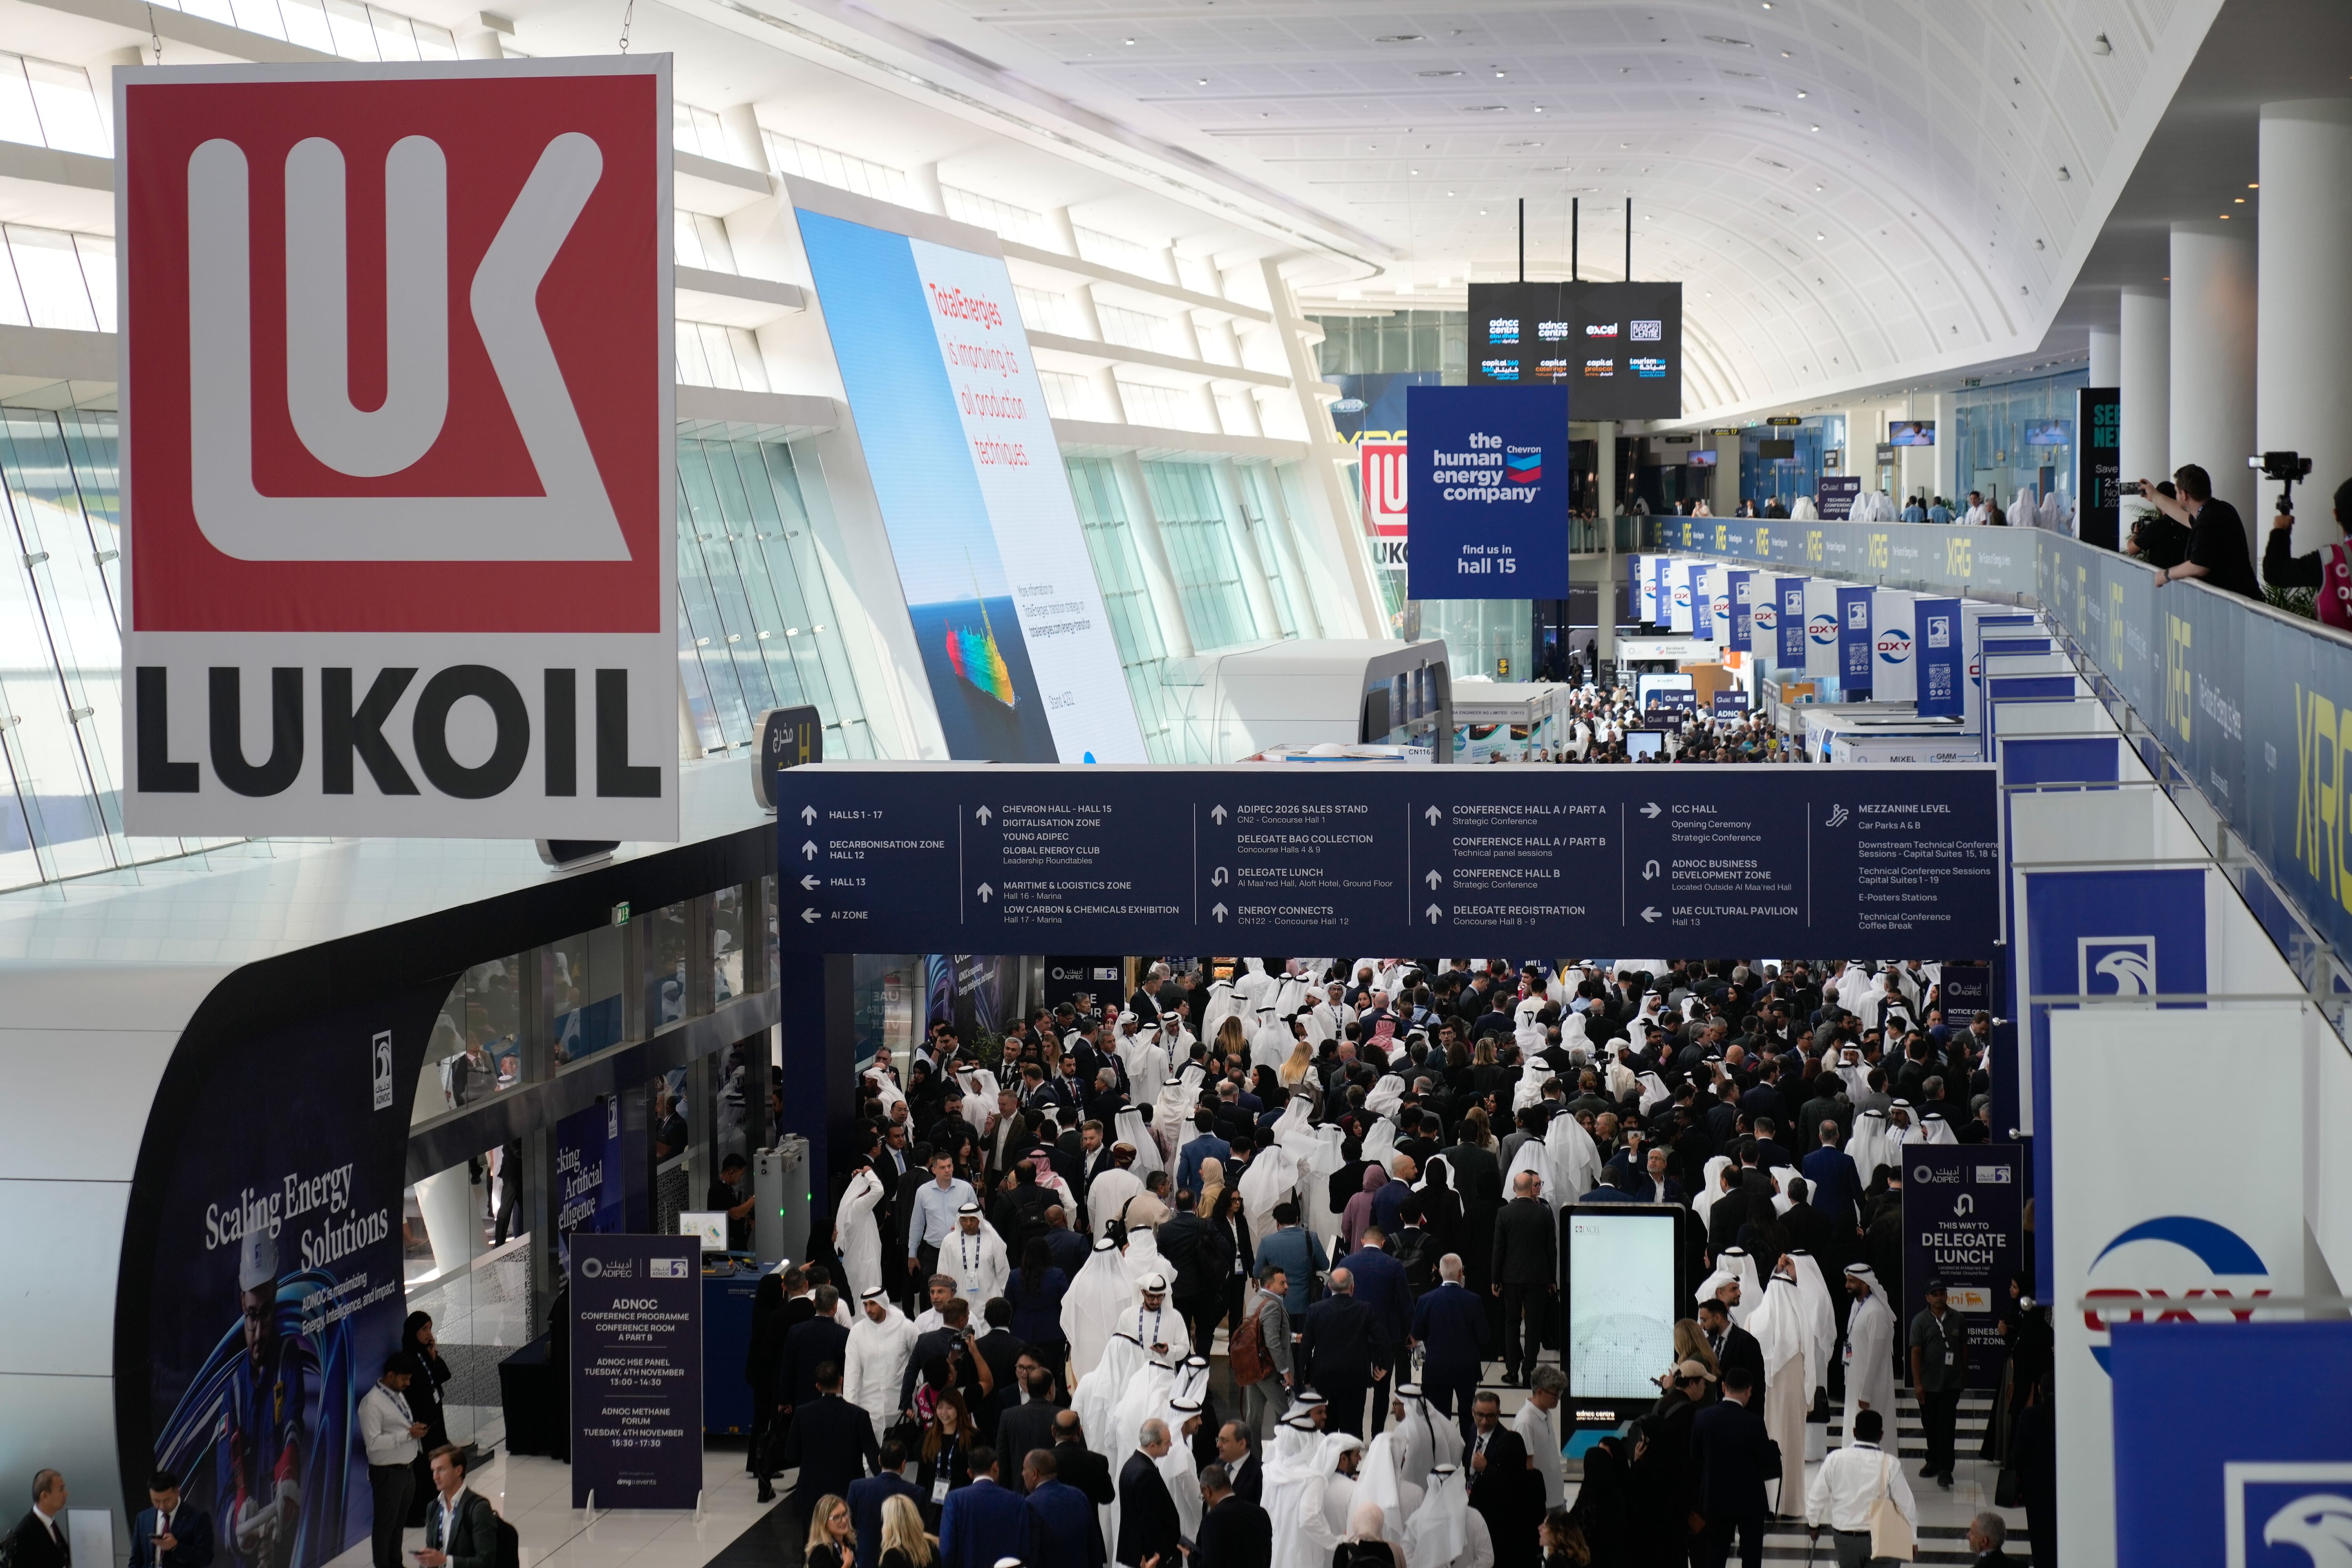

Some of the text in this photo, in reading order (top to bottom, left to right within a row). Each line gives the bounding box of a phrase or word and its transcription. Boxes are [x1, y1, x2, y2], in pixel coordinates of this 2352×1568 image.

[930, 283, 1002, 330] TotalEnergies
[1586, 323, 1618, 334] excel
[944, 333, 1018, 378] is improving its
[1541, 359, 1567, 367] capital
[1587, 359, 1613, 367] capital
[962, 384, 1027, 421] oil production
[1469, 432, 1502, 448] the
[1434, 450, 1502, 466] human
[2096, 464, 2118, 473] Save
[1433, 470, 1503, 486] energy
[1462, 545, 1484, 554] find
[1502, 545, 1511, 554] in
[1806, 531, 1822, 562] XRG
[1868, 534, 1887, 568] XRG
[1947, 537, 1971, 577] XRG
[1458, 558, 1516, 573] hall 15
[1878, 641, 1911, 651] OXY
[2166, 611, 2191, 743] XRG
[135, 664, 661, 800] LUKOIL
[773, 722, 793, 753] مخرج
[1275, 805, 1300, 814] 2026
[1335, 805, 1368, 813] STAND
[1672, 805, 1717, 813] ICC HALL
[1859, 804, 1951, 813] MEZZANINE LEVEL
[1453, 817, 1489, 826] Strategic
[1671, 820, 1751, 830] Opening Ceremony
[1238, 868, 1323, 877] DELEGATE LUNCH
[1454, 906, 1585, 915] DELEGATE REGISTRATION
[1672, 906, 1798, 915] UAE CULTURAL PAVILION
[376, 1092, 390, 1105] ADNOC
[565, 1159, 602, 1201] Artificial
[206, 1163, 353, 1251] Scaling Energy
[301, 1208, 388, 1273] Solutions
[1922, 1233, 2006, 1247] DELEGATE
[1935, 1249, 1993, 1264] LUNCH
[302, 1288, 327, 1313] ADNOC
[333, 1272, 367, 1300] maximizing
[612, 1299, 658, 1310] ADNOC
[584, 1368, 621, 1377] TUESDAY,
